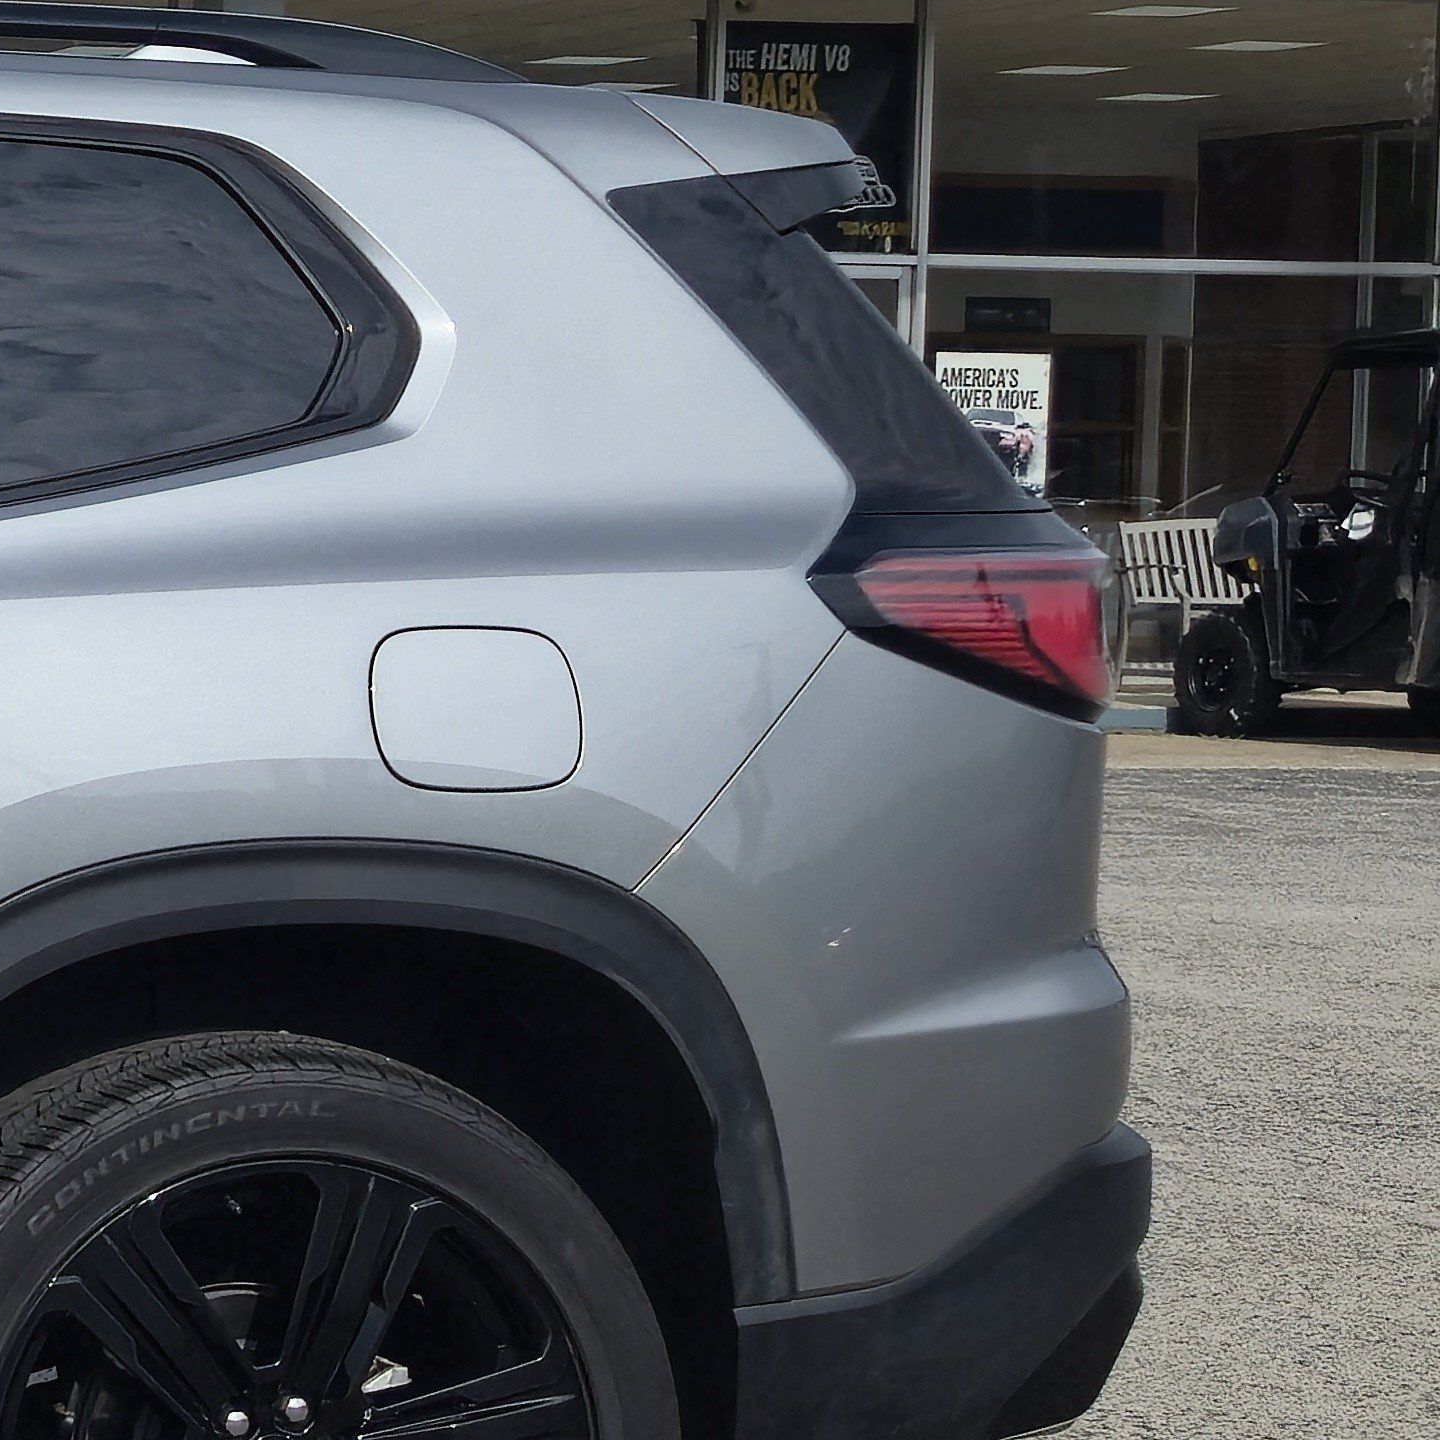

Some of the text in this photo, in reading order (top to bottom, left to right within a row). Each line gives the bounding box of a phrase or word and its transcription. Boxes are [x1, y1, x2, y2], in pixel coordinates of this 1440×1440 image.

[727, 42, 851, 72] THE HEMI V8
[741, 71, 819, 112] BACK
[940, 367, 1019, 388] AMERICA'S
[944, 389, 1043, 410] OWER MOVE.
[26, 1099, 338, 1237] CONTINENTAL
